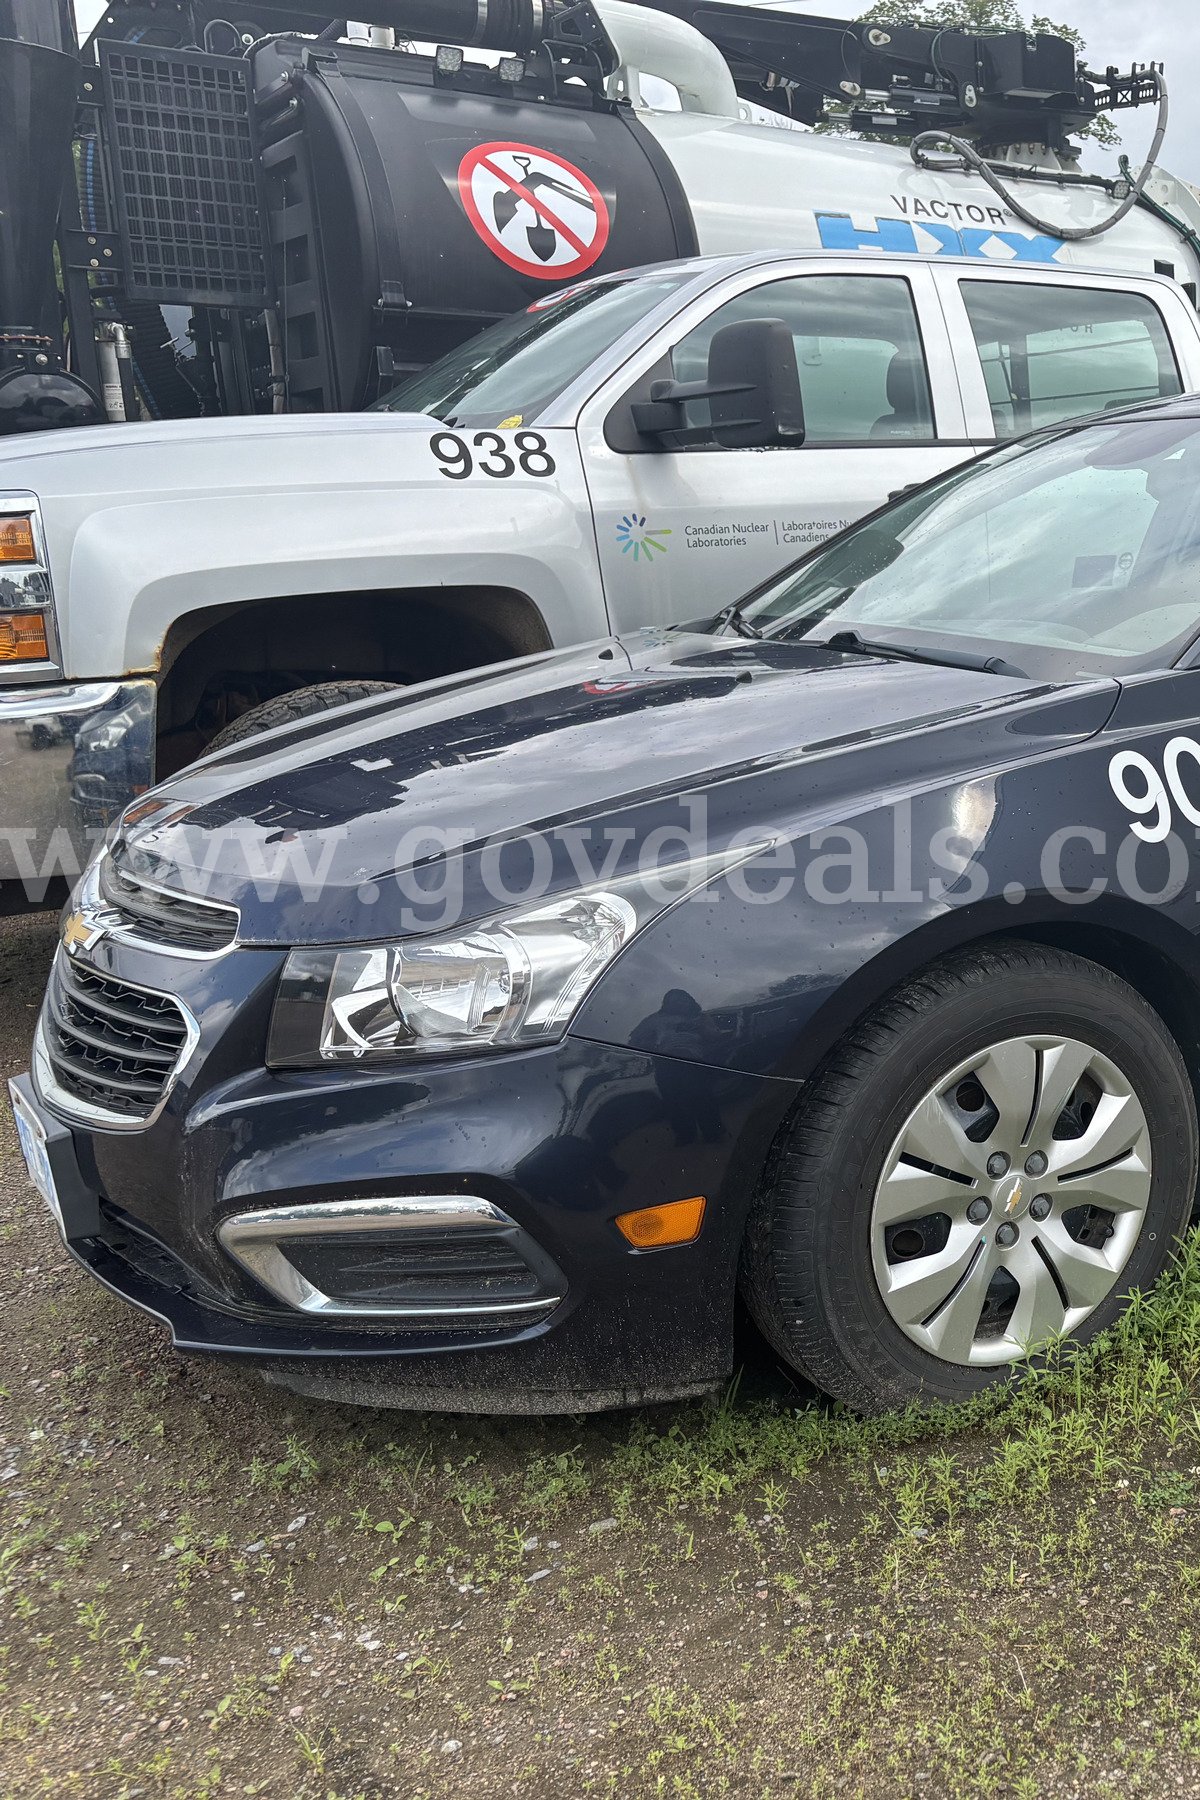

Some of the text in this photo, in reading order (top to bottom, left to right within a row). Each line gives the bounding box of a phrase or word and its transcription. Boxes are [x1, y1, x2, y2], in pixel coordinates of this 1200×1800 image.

[430, 431, 556, 480] 938
[684, 522, 770, 536] Canadian Nuclear
[782, 520, 837, 532] Laboratoires
[687, 536, 747, 548] Laboratories
[783, 532, 830, 543] Canadiens
